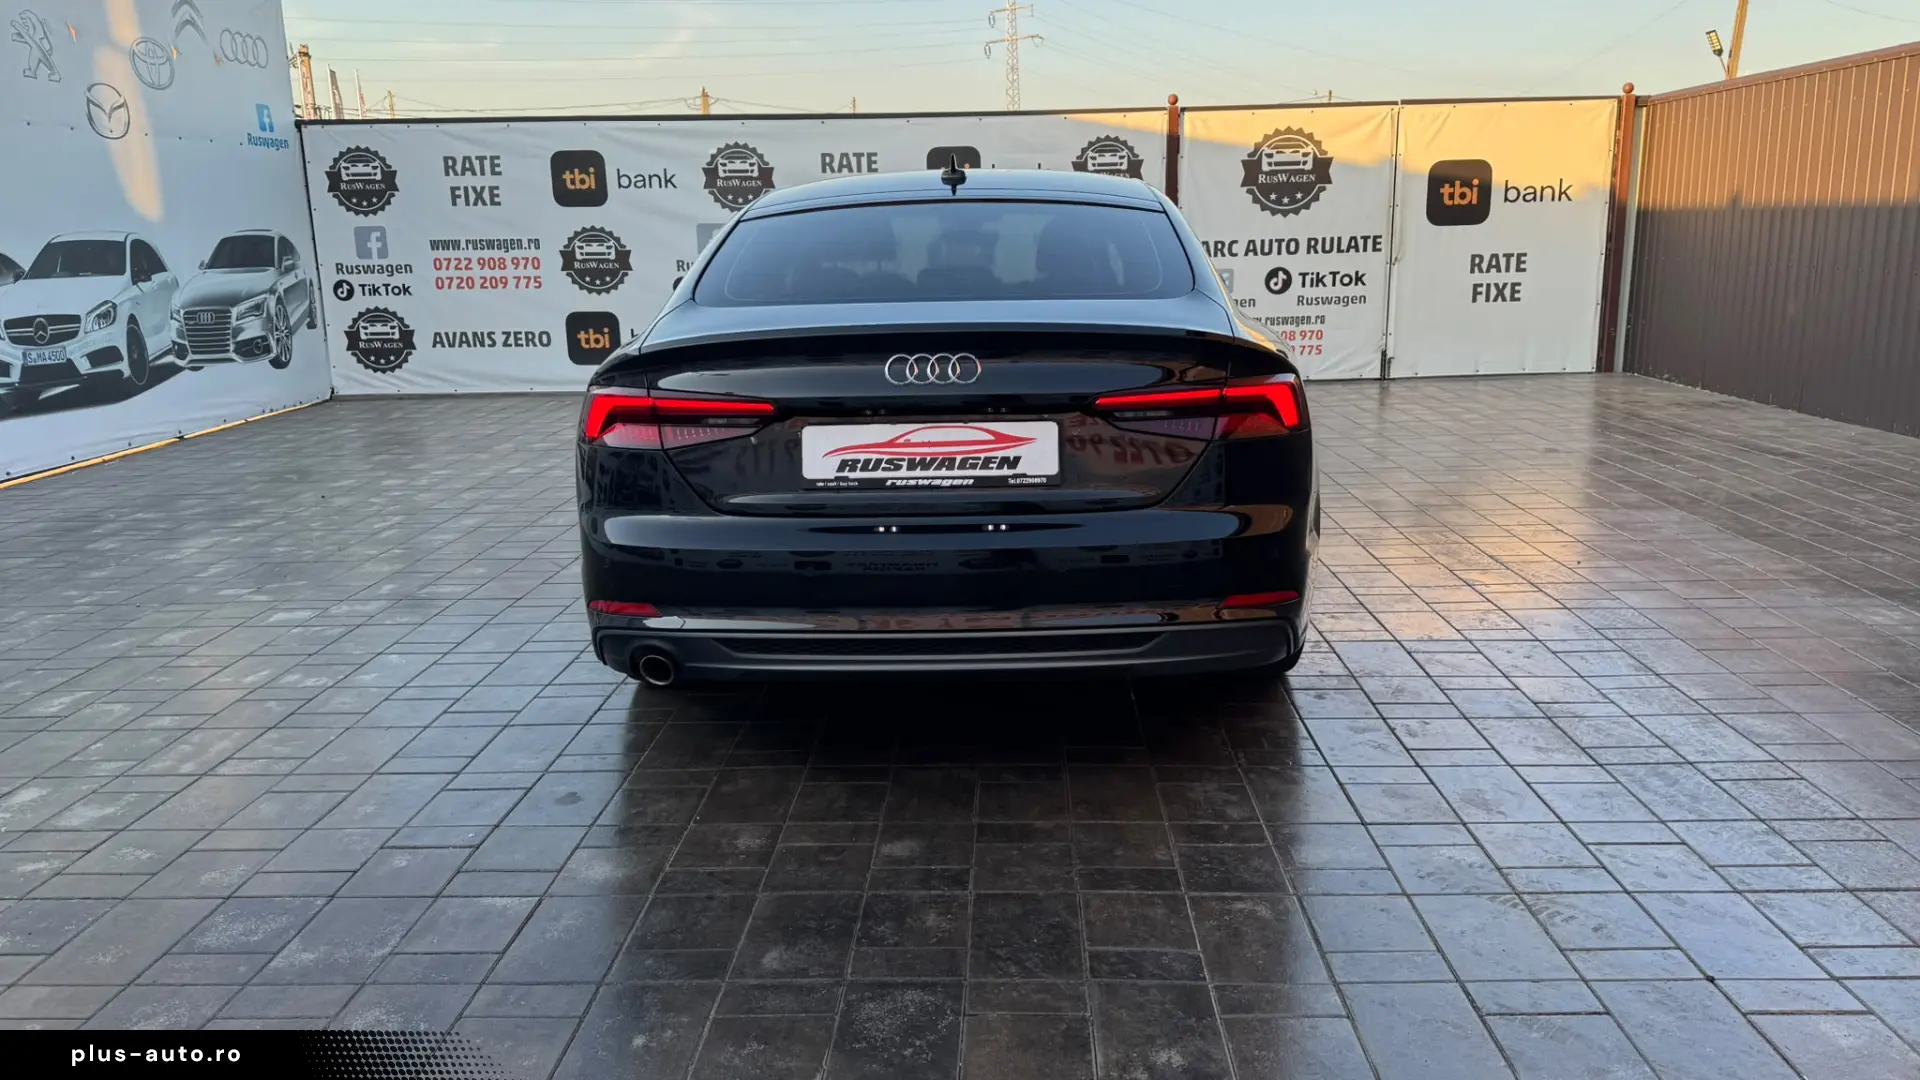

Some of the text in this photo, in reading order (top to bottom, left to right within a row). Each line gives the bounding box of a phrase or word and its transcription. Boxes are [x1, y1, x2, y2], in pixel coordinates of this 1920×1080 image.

[247, 133, 289, 151] Ruswagen
[443, 155, 503, 177] RATE
[821, 152, 878, 173] RATE
[562, 168, 678, 190] tbi bank
[450, 186, 501, 207] FIXE
[1440, 178, 1572, 206] tbi bank
[429, 237, 541, 252] www.ruswagen.ro
[1202, 235, 1382, 257] ARC AUTO RULATE
[336, 262, 413, 277] Ruswagen
[433, 257, 541, 271] 0722 908 970
[1470, 252, 1527, 274] RATE
[435, 276, 542, 290] 0720 209 775
[1299, 270, 1366, 288] TikTok
[358, 283, 412, 297] TikTok
[1471, 282, 1521, 303] FIXE
[1297, 295, 1366, 307] Ruswagen
[432, 331, 551, 348] AVANS ZERO
[577, 328, 610, 349] tbi
[1281, 330, 1323, 341] 08 970
[1300, 345, 1322, 355] 775
[836, 456, 1021, 473] RUSWAGEN
[886, 478, 974, 487] ruswagen
